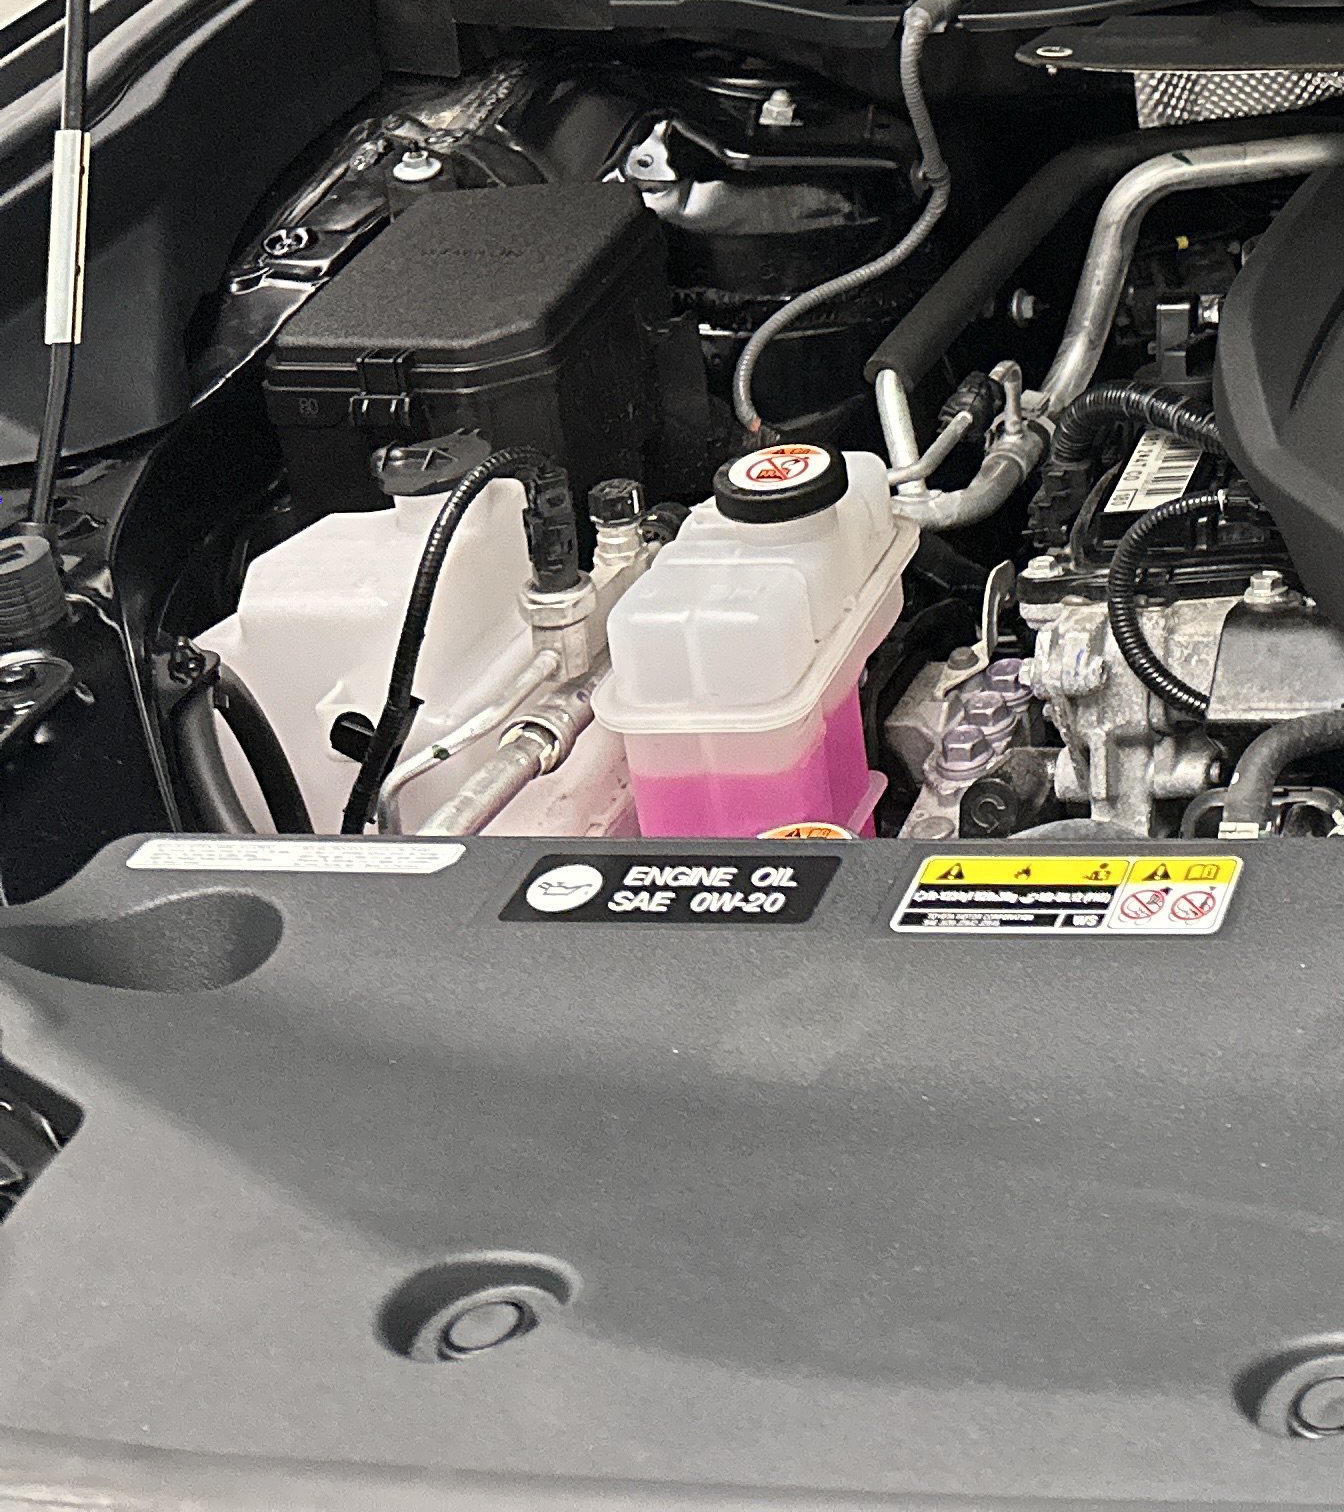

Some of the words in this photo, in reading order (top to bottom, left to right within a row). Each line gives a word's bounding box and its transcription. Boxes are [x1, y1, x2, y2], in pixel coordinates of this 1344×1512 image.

[623, 865, 739, 888] ENGINE
[750, 866, 799, 888] OIL
[607, 890, 677, 913] SAE
[690, 890, 787, 913] 0W-20
